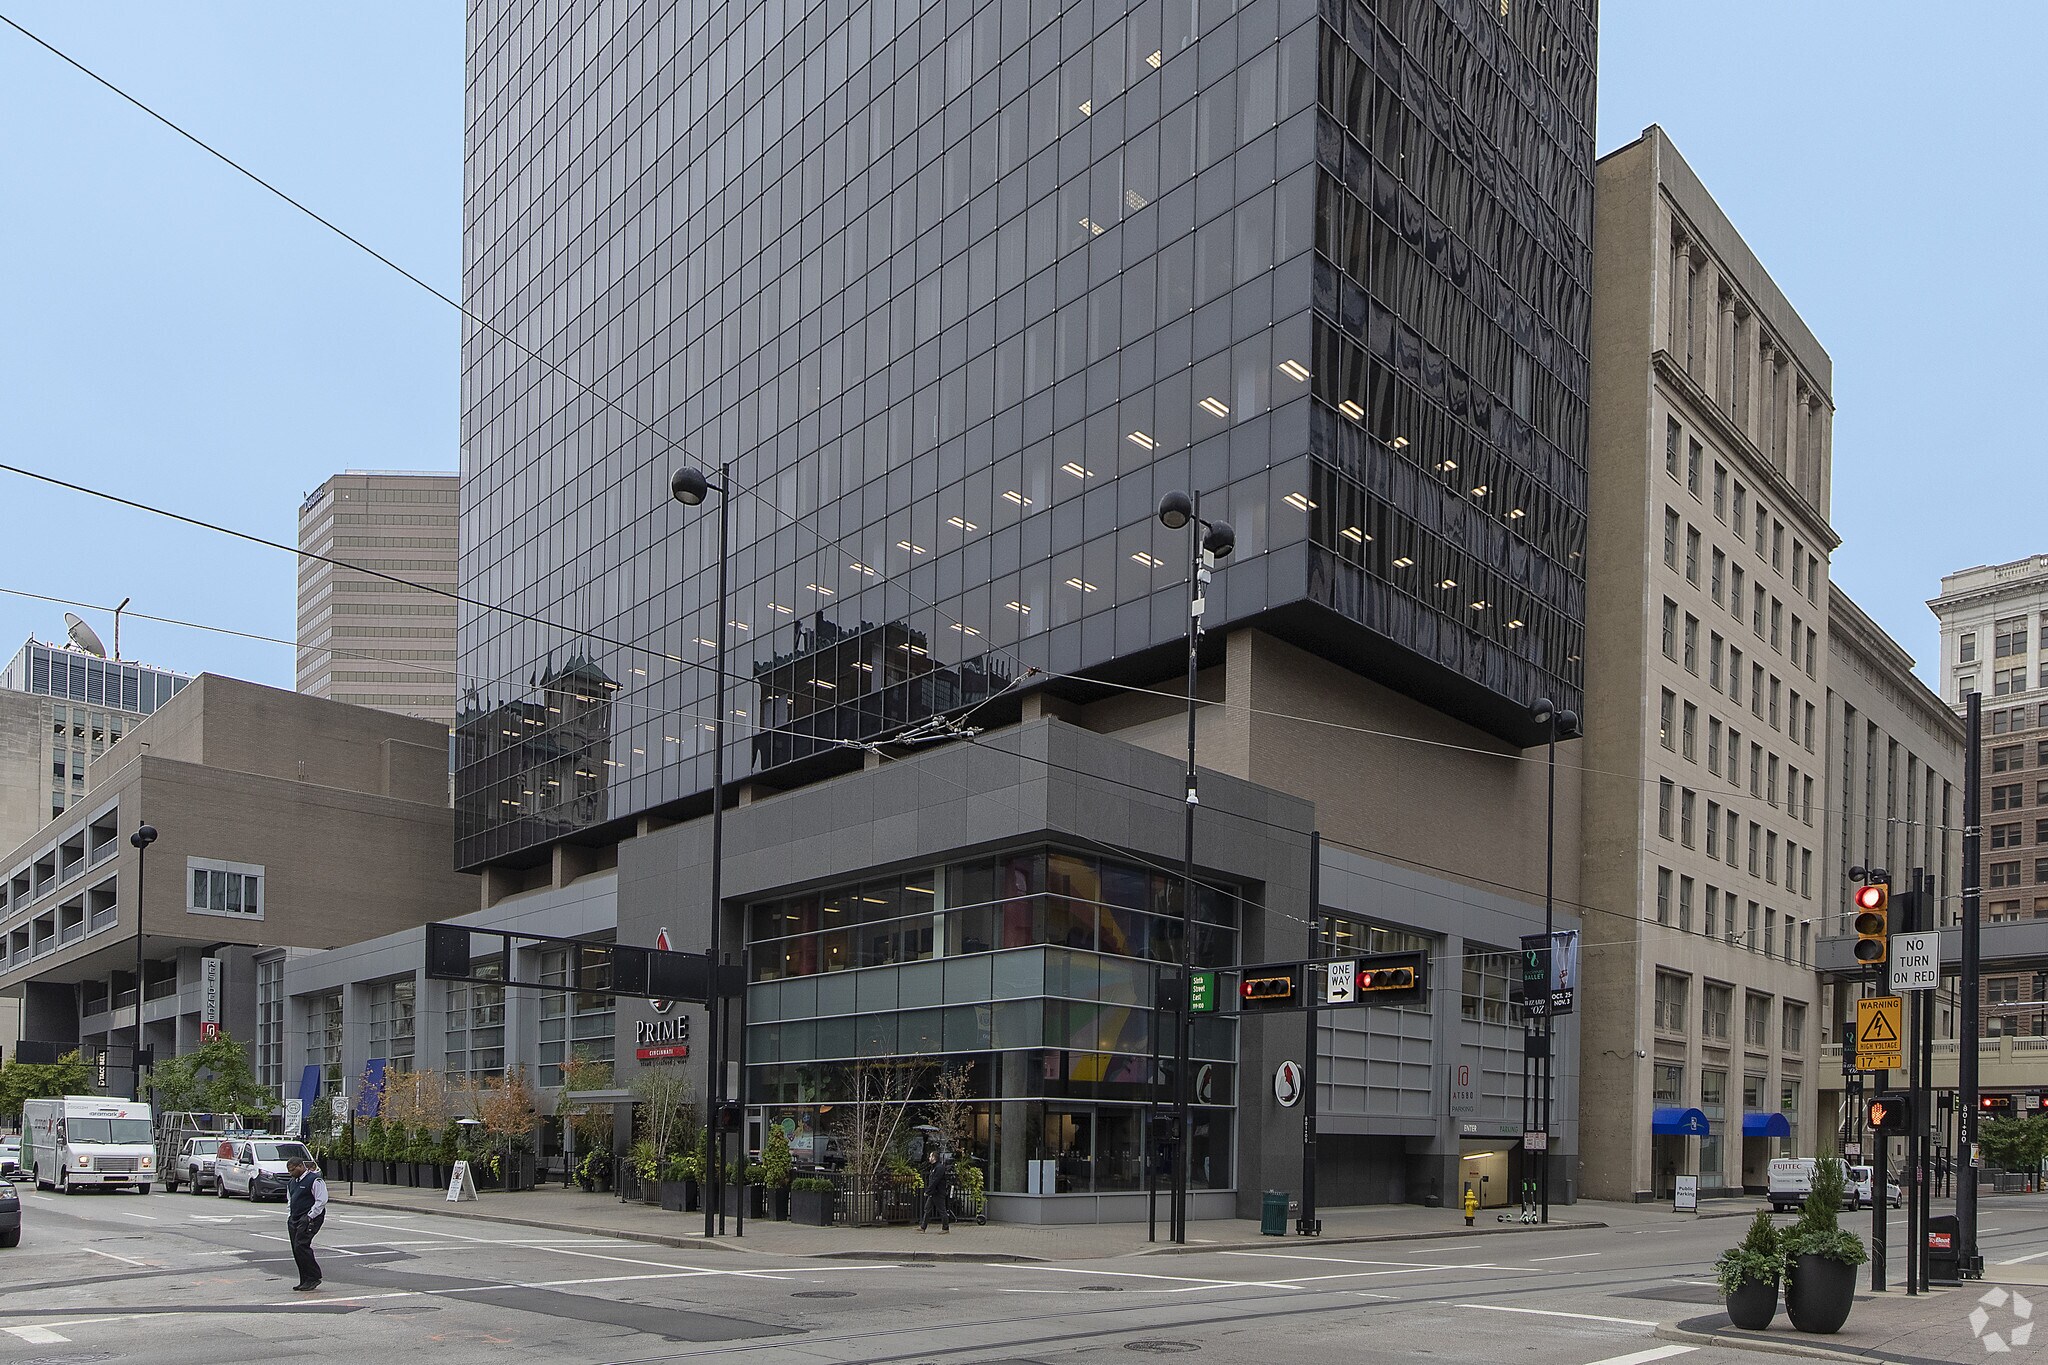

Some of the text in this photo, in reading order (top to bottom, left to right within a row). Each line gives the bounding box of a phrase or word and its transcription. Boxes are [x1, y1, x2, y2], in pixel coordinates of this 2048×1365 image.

[1906, 940, 1924, 951] NO
[1900, 955, 1929, 967] TURN
[1332, 964, 1350, 974] ONE
[1331, 975, 1350, 986] WAY
[1893, 971, 1935, 983] ON RED
[208, 960, 216, 1022] RESIDENCE
[1860, 1000, 1899, 1010] WARNING
[635, 1015, 686, 1043] PRIME
[1876, 1042, 1898, 1050] VOLTAGE
[1861, 1057, 1877, 1067] 17'
[1887, 1056, 1897, 1067] 1"
[1453, 1091, 1474, 1100] AT580
[1463, 1124, 1477, 1133] ENTER
[1773, 1163, 1802, 1171] FUJITEC
